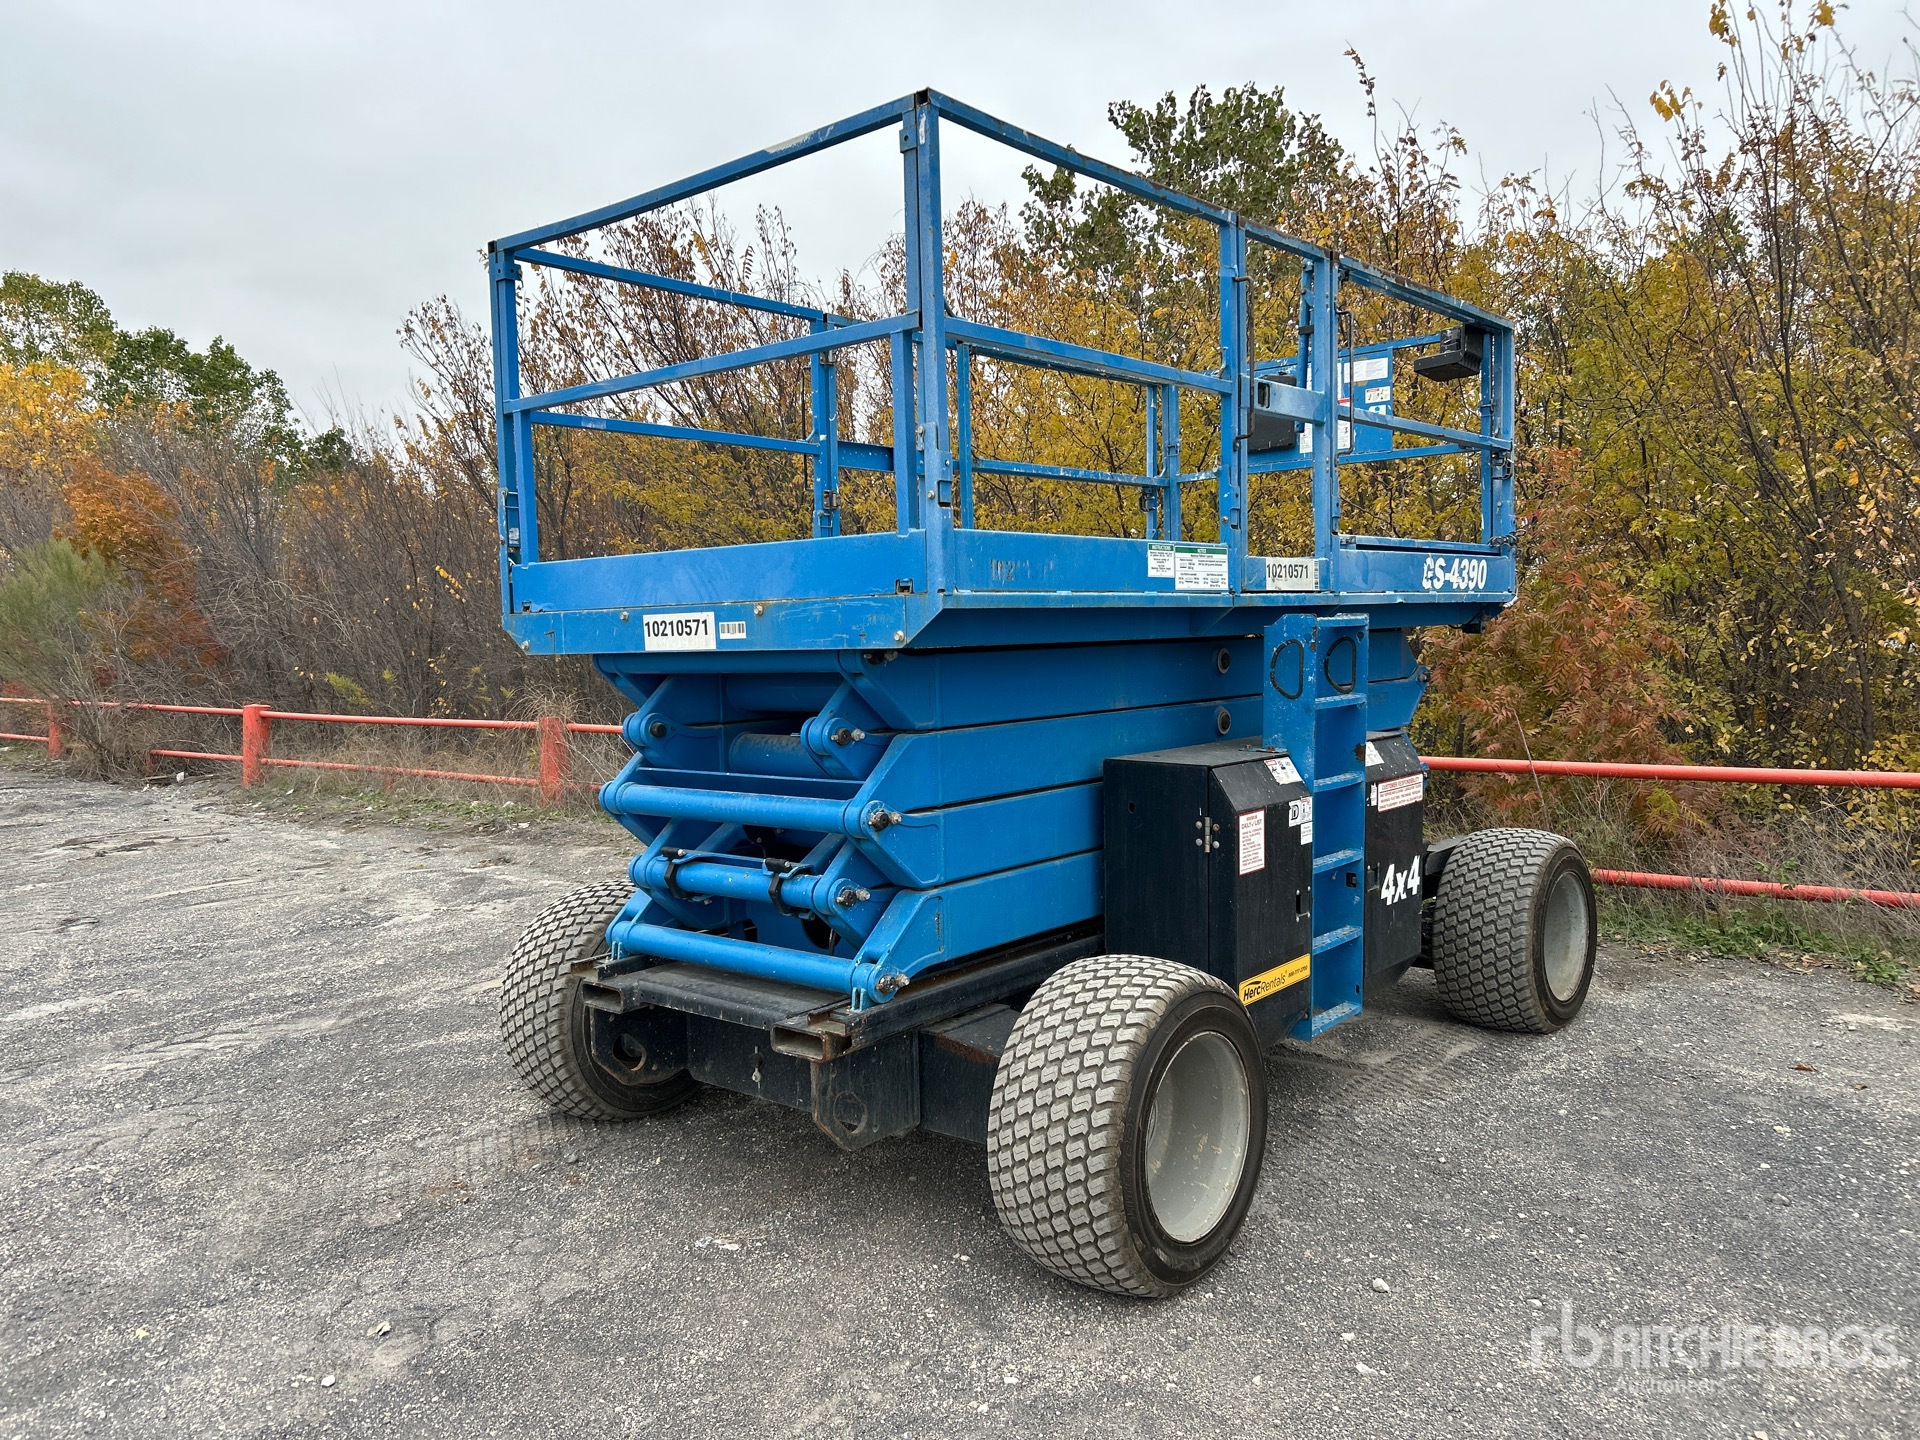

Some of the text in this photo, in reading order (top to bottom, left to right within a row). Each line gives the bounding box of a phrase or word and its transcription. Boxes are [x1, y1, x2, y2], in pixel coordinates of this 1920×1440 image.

[1266, 563, 1309, 579] 10210571
[644, 618, 709, 638] 10210571
[1380, 854, 1421, 906] 4x4
